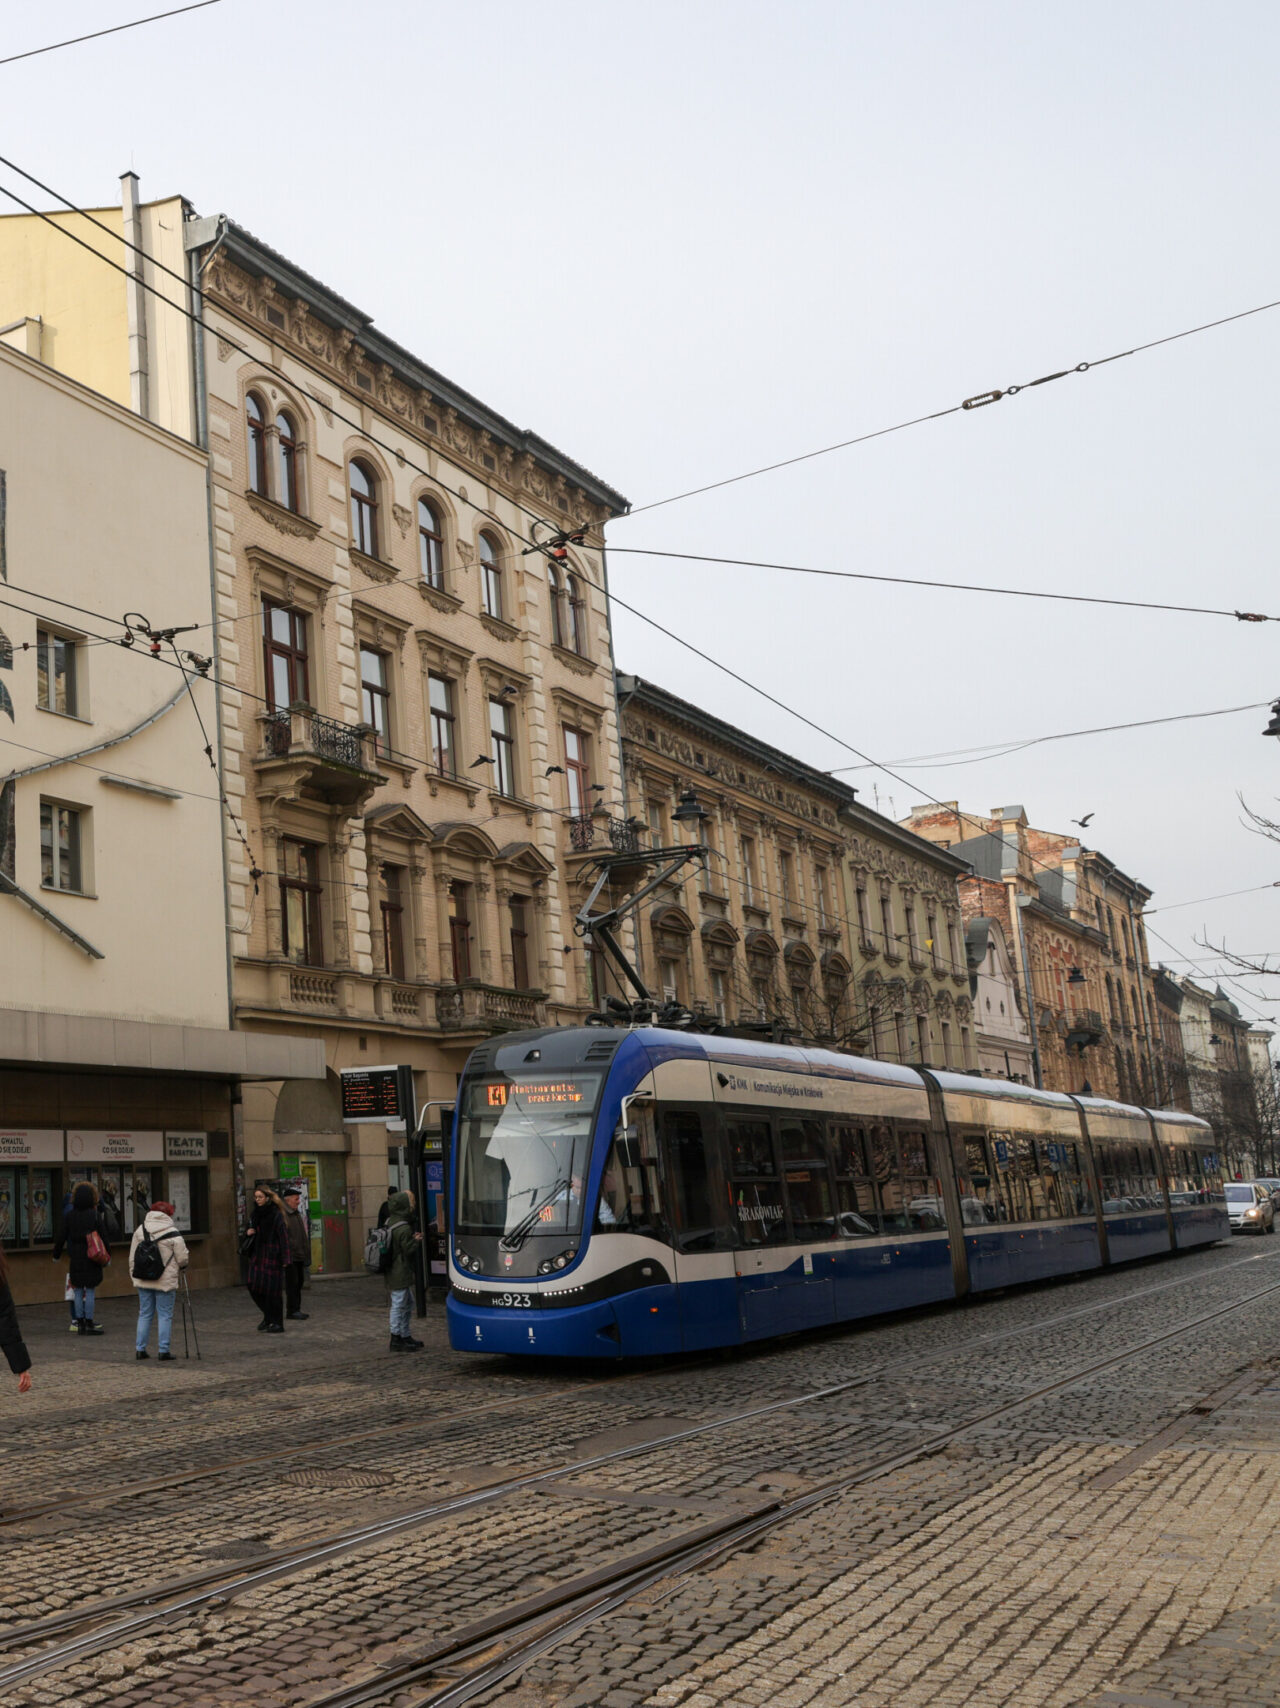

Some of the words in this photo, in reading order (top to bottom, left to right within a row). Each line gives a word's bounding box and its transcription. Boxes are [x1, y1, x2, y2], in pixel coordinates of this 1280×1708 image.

[753, 1080, 782, 1096] Komunikacja
[167, 1137, 204, 1148] TEATR
[738, 1204, 784, 1222] KRAKOWIAK
